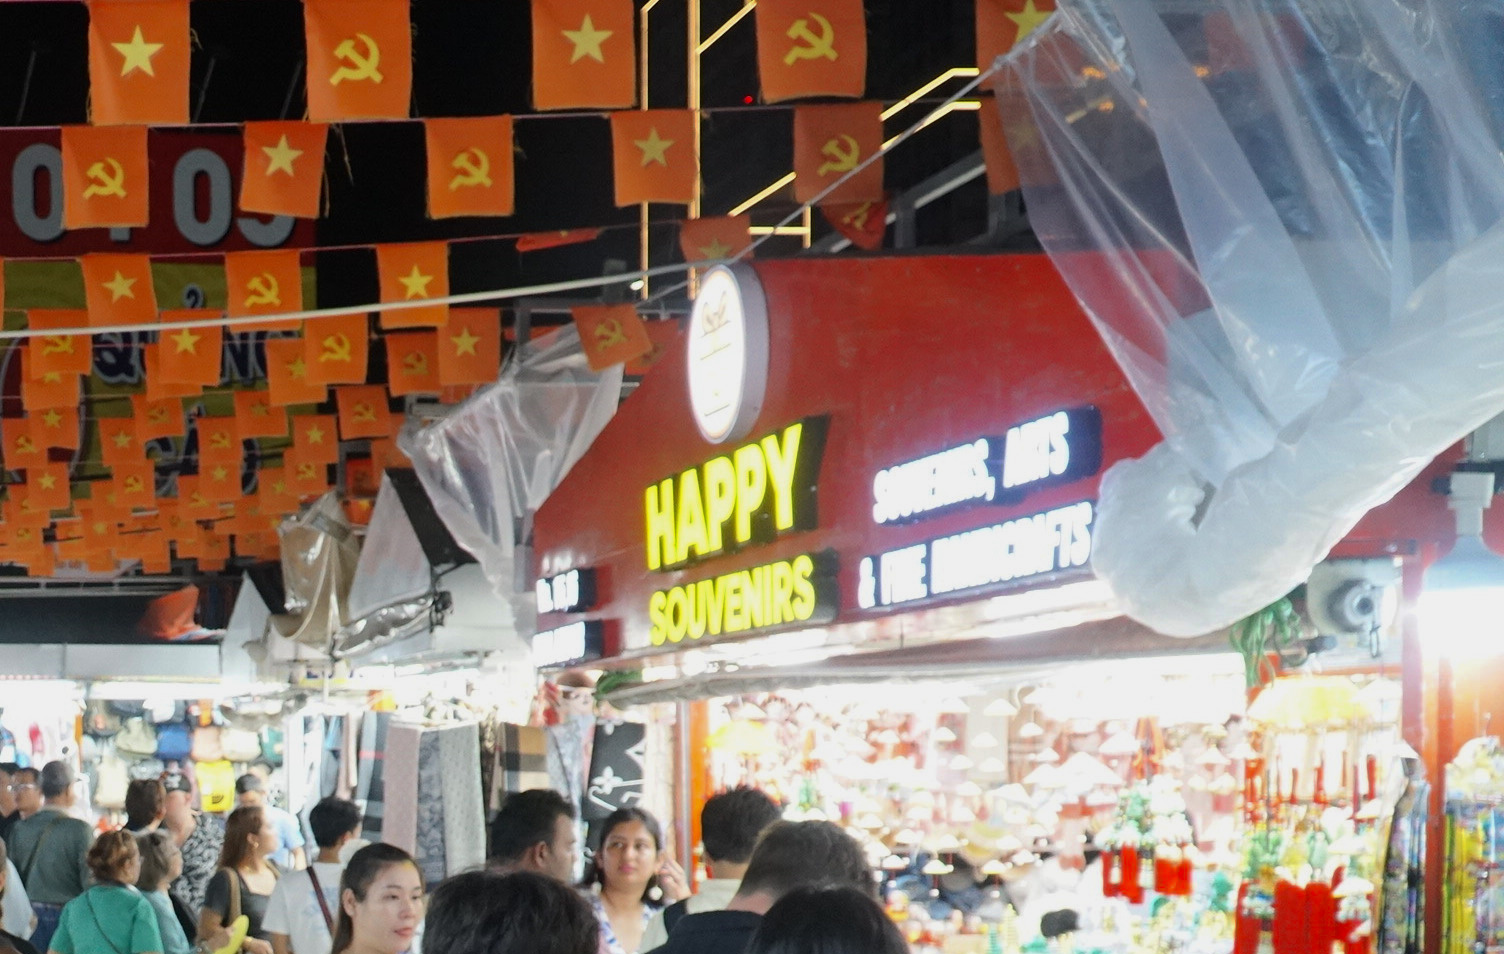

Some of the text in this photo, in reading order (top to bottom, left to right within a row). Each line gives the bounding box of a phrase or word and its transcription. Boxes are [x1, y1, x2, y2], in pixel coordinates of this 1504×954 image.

[11, 143, 136, 243] 0
[645, 423, 803, 571] HAPPY
[1003, 411, 1070, 488] ARTS
[649, 555, 816, 647] SOUVENIRS
